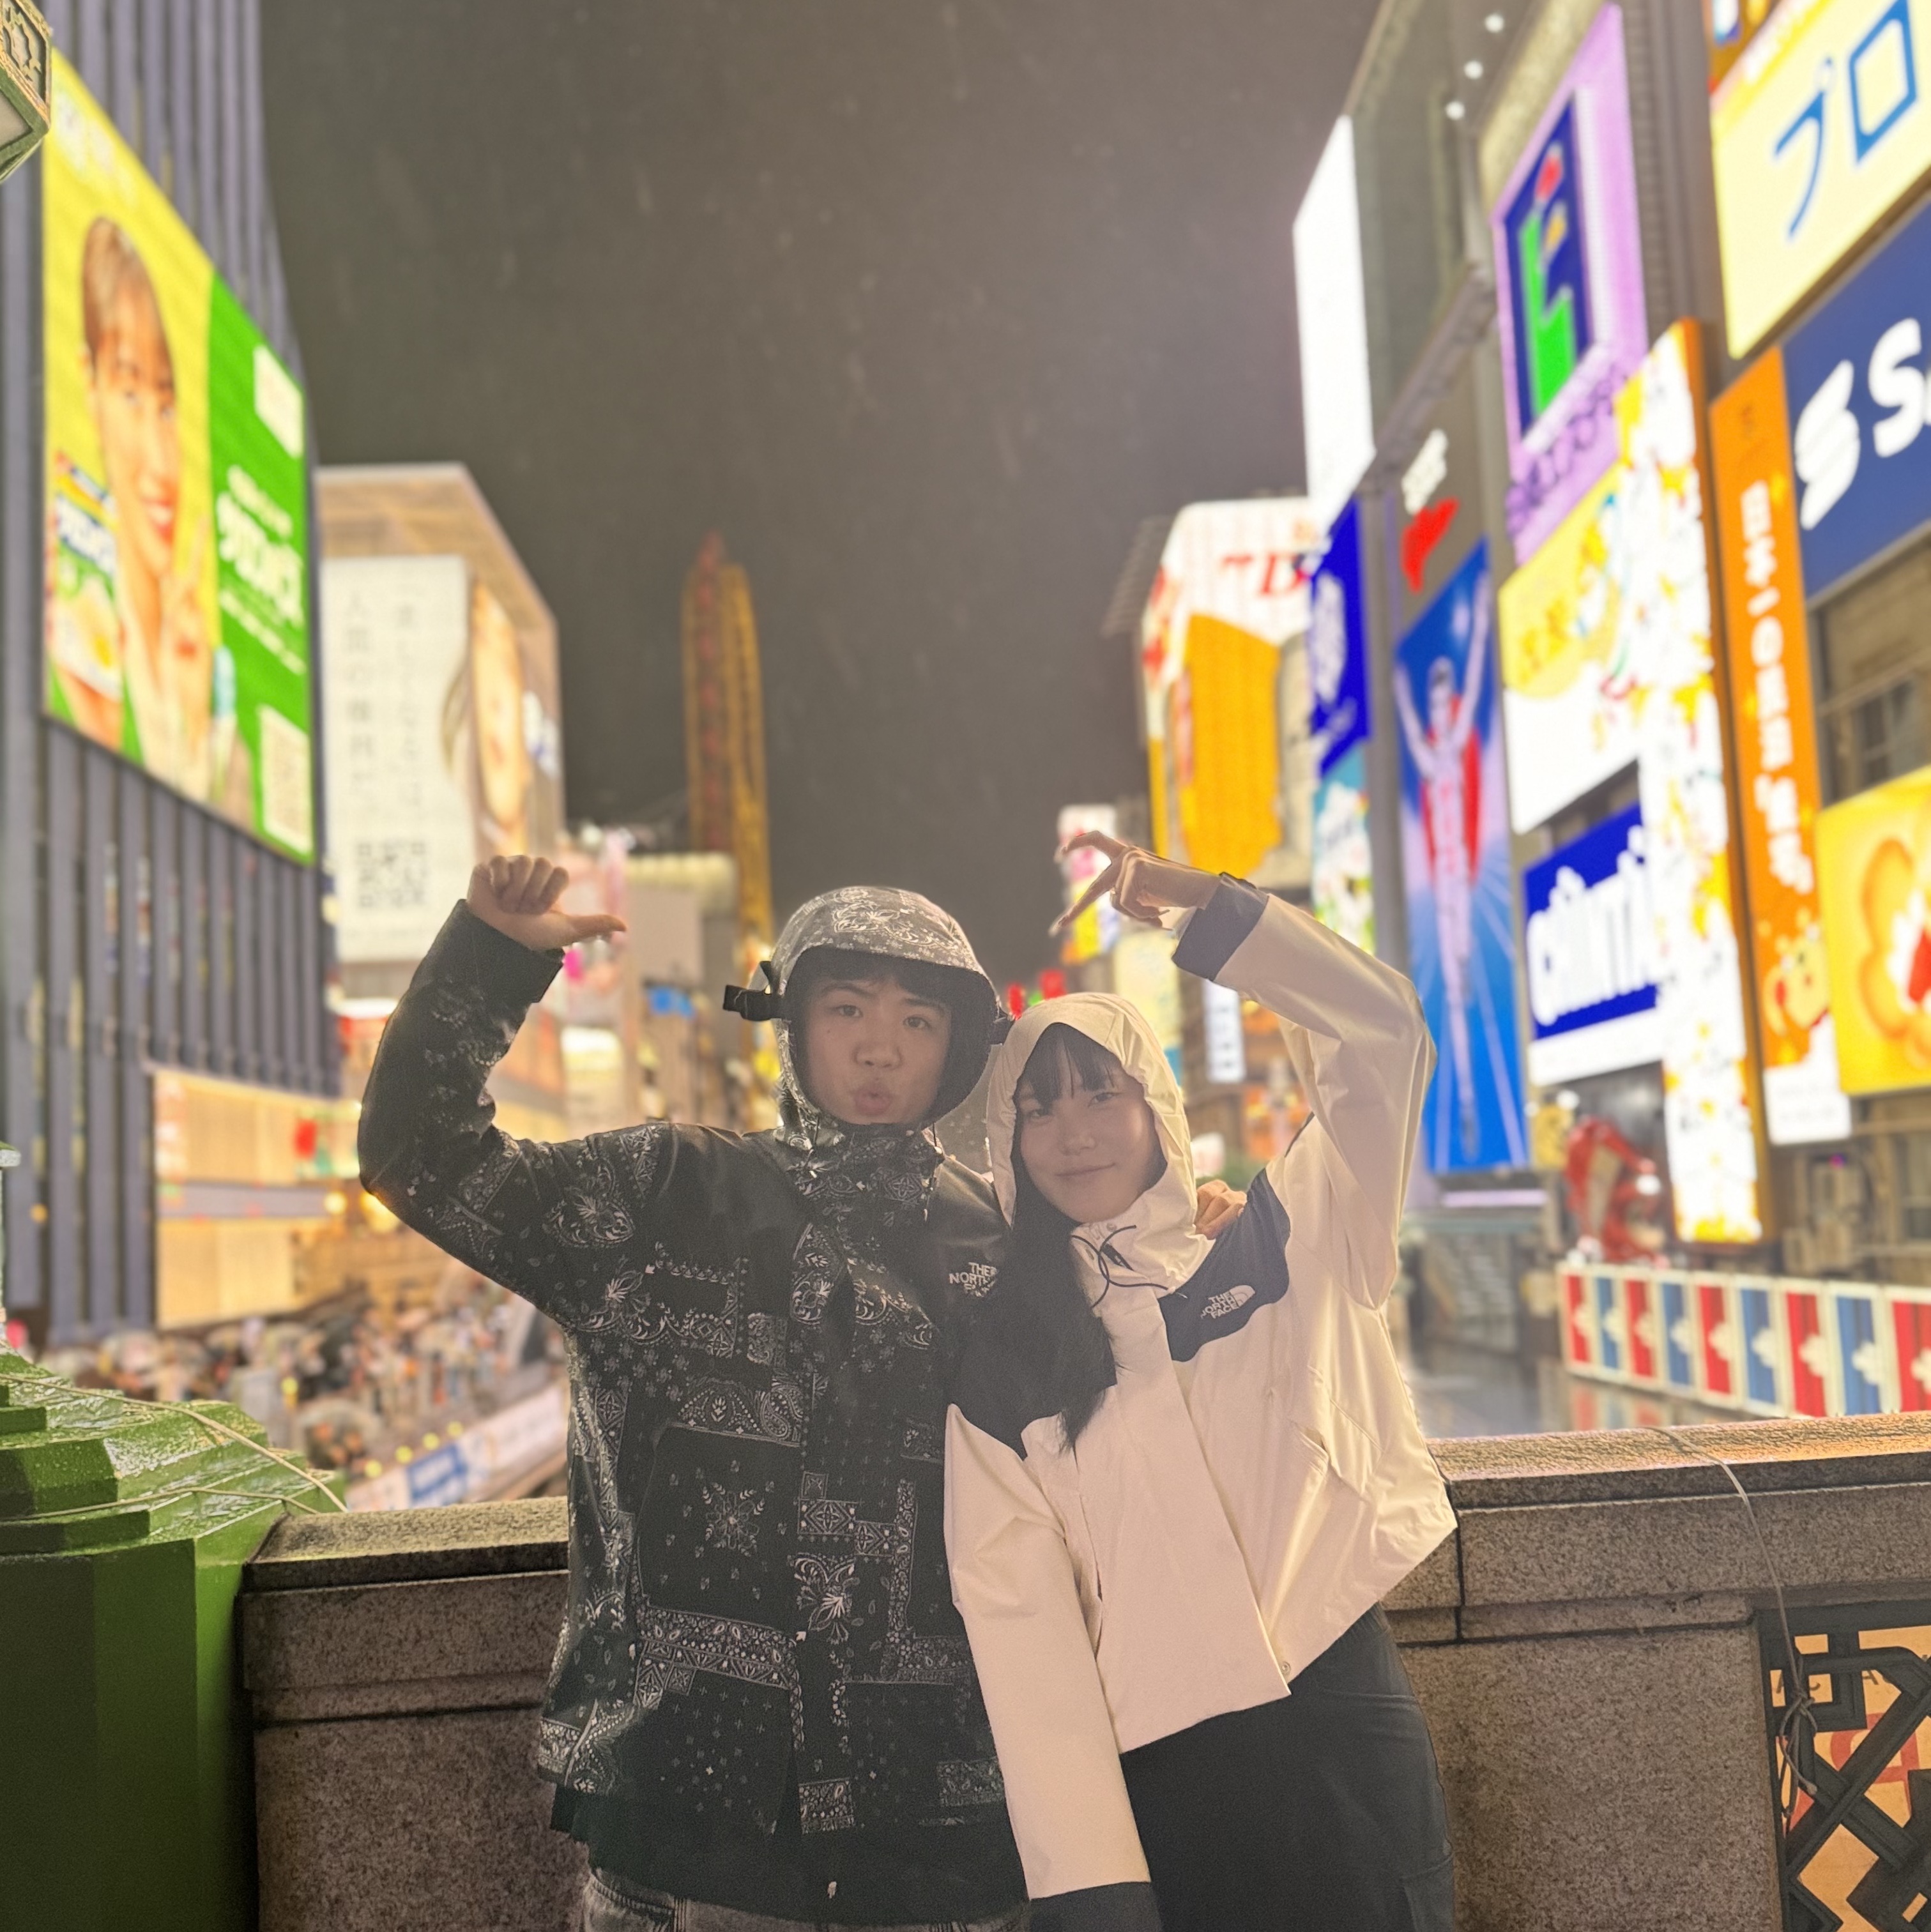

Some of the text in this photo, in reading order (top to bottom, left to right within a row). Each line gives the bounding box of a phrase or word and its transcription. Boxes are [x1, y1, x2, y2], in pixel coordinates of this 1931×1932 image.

[968, 1262, 991, 1277] THE
[1208, 1291, 1232, 1304] THE
[1210, 1302, 1239, 1320] FACE
